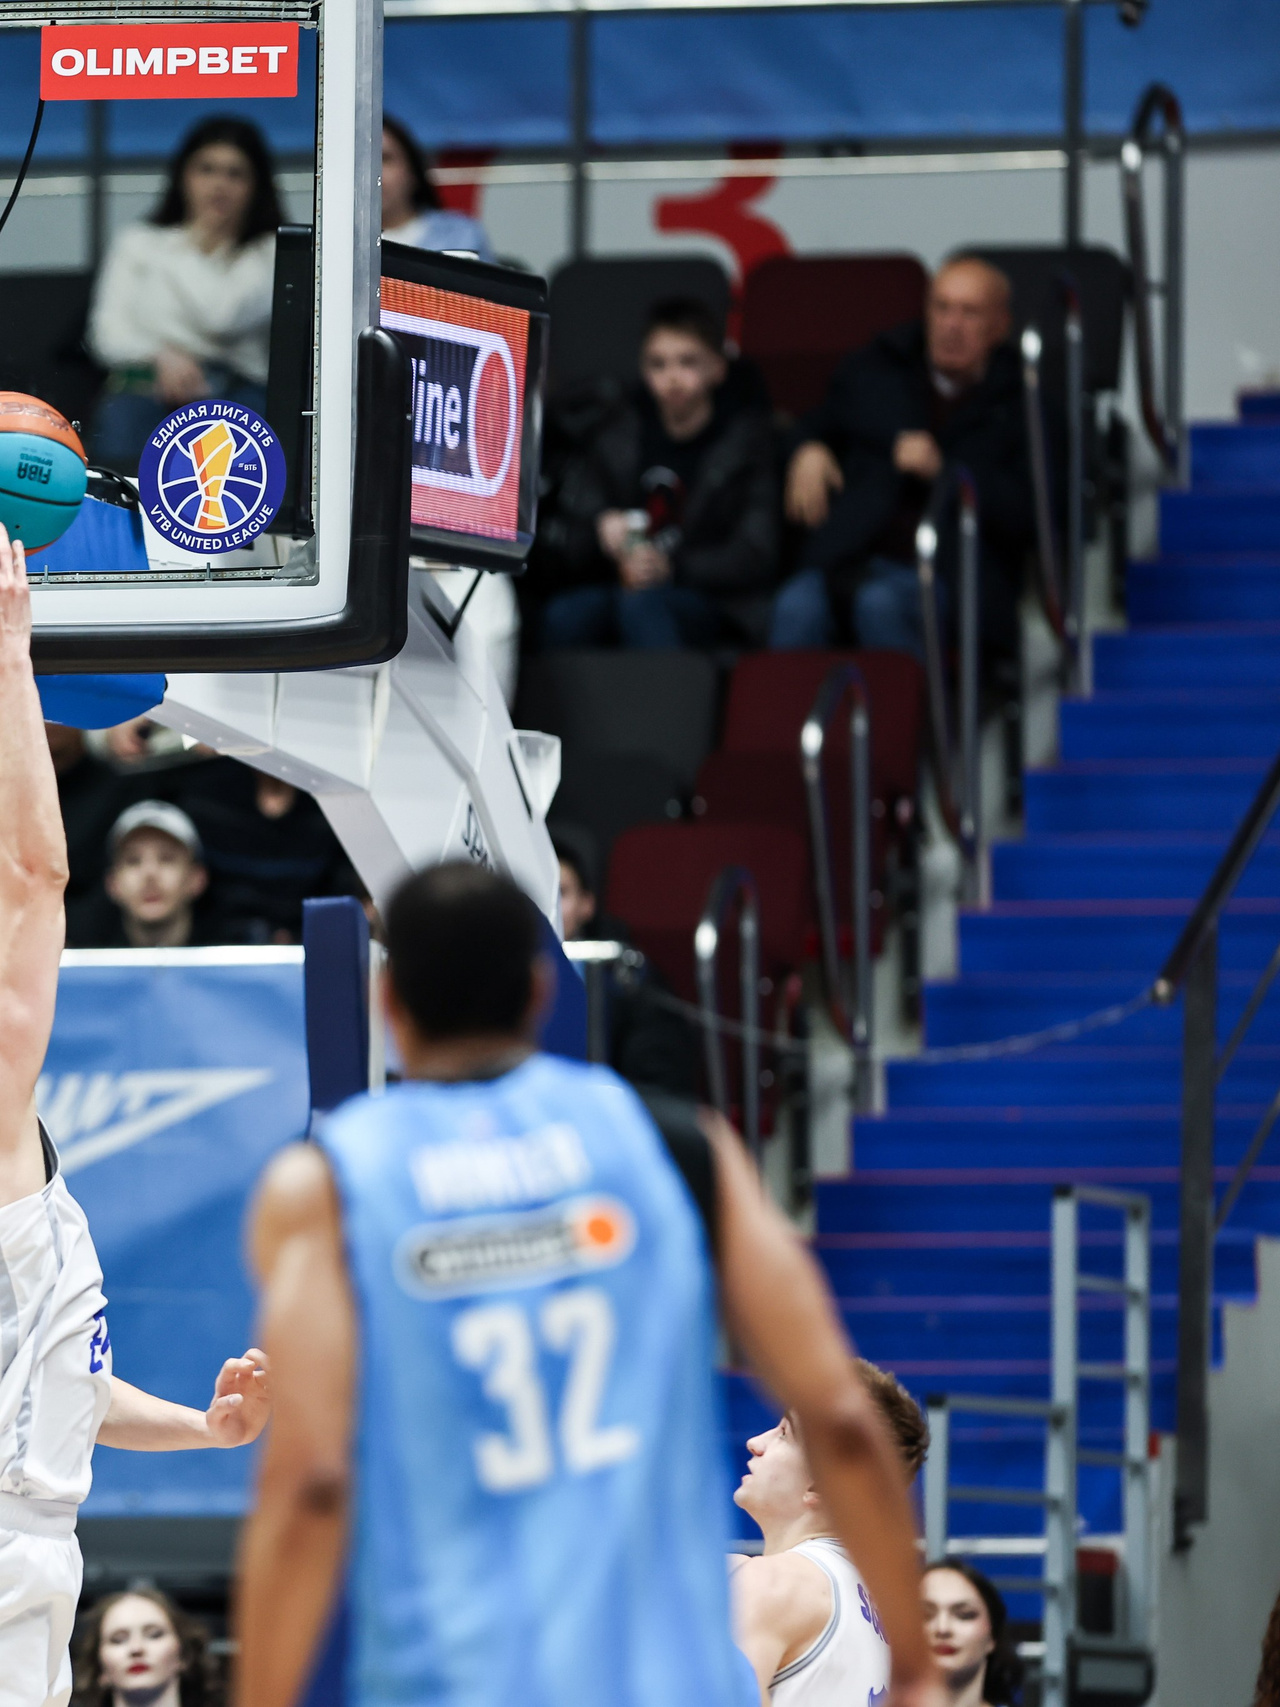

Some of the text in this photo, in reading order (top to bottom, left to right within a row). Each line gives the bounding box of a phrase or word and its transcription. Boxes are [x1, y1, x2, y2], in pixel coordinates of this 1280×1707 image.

[50, 45, 288, 76] OLIMPBET
[411, 357, 462, 450] ine
[151, 404, 274, 449] ЕДИНАЯ ЛИГА ВТБ
[17, 461, 52, 485] FIBA
[243, 463, 258, 471] ВТБ
[150, 504, 274, 550] VTB UNITED LEAGUE
[452, 1287, 639, 1491] 32
